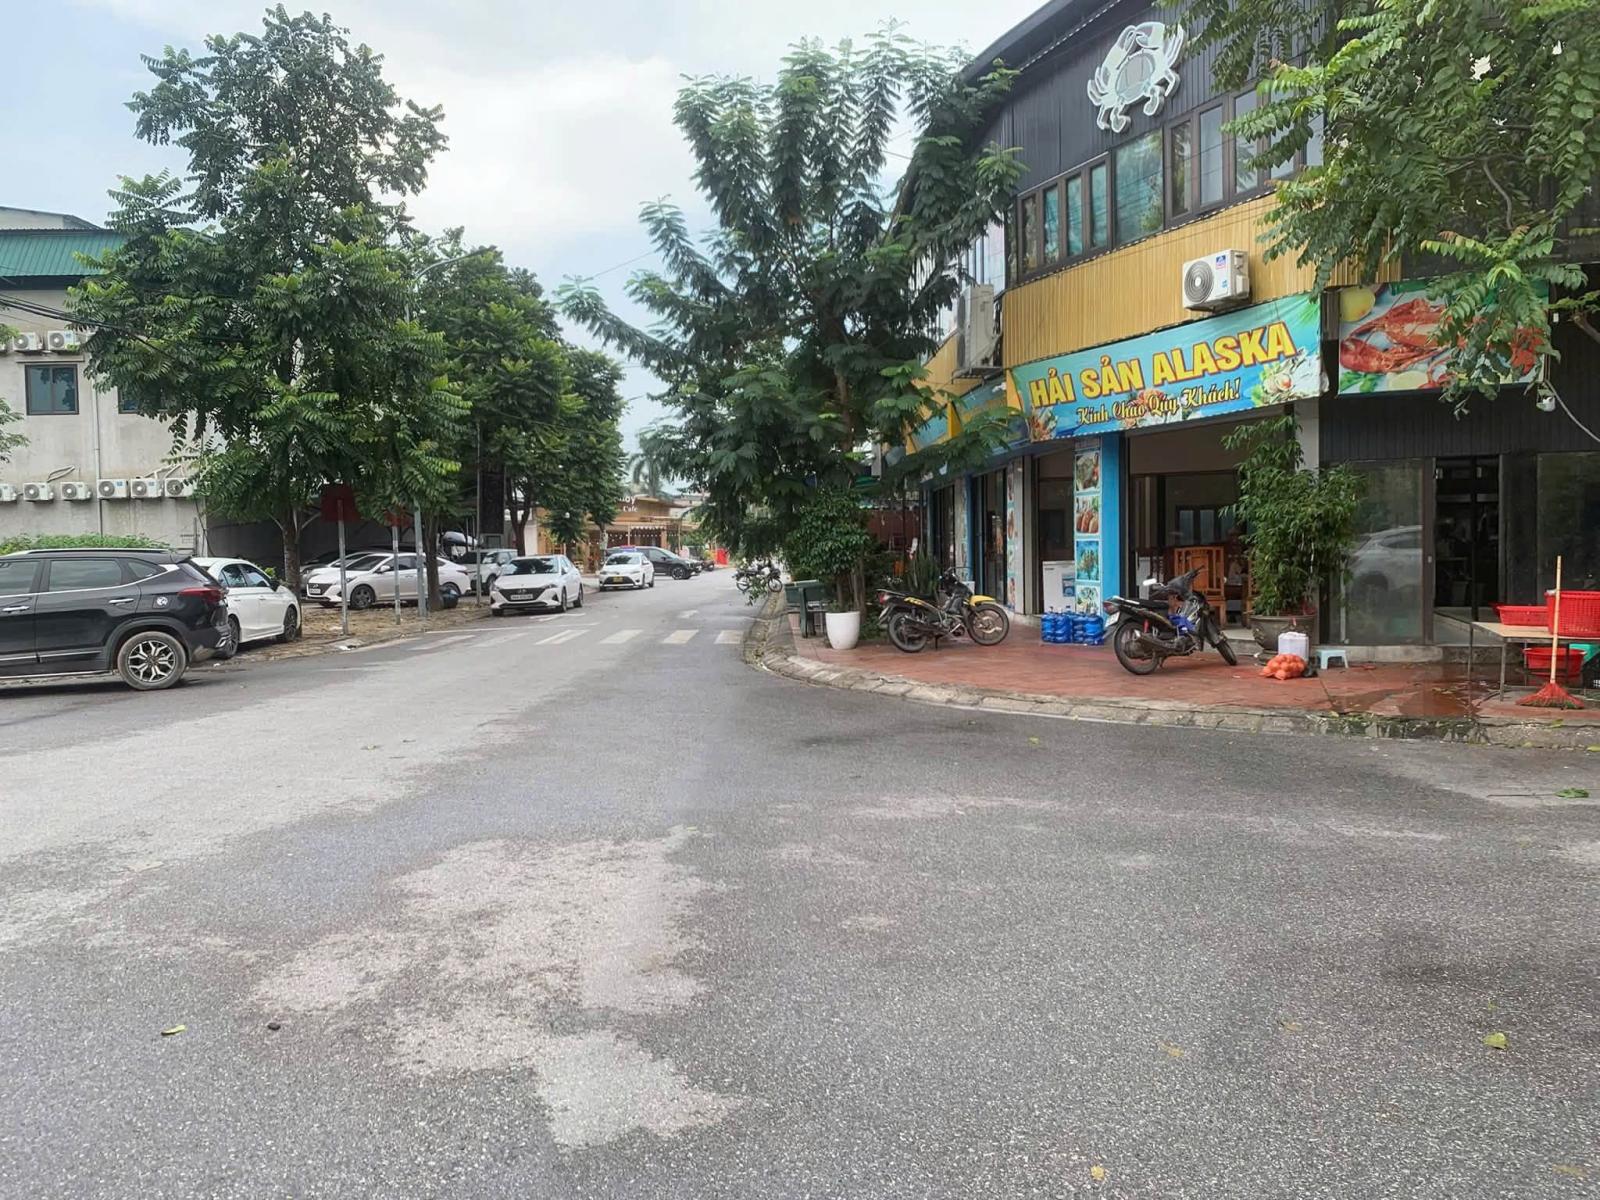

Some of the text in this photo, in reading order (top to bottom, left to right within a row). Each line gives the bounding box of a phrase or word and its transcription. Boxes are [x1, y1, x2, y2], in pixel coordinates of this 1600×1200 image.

[1029, 322, 1297, 408] HẢI SẢN ALASKA
[1077, 405, 1109, 426] Kính
[1181, 377, 1242, 409] Khách!
